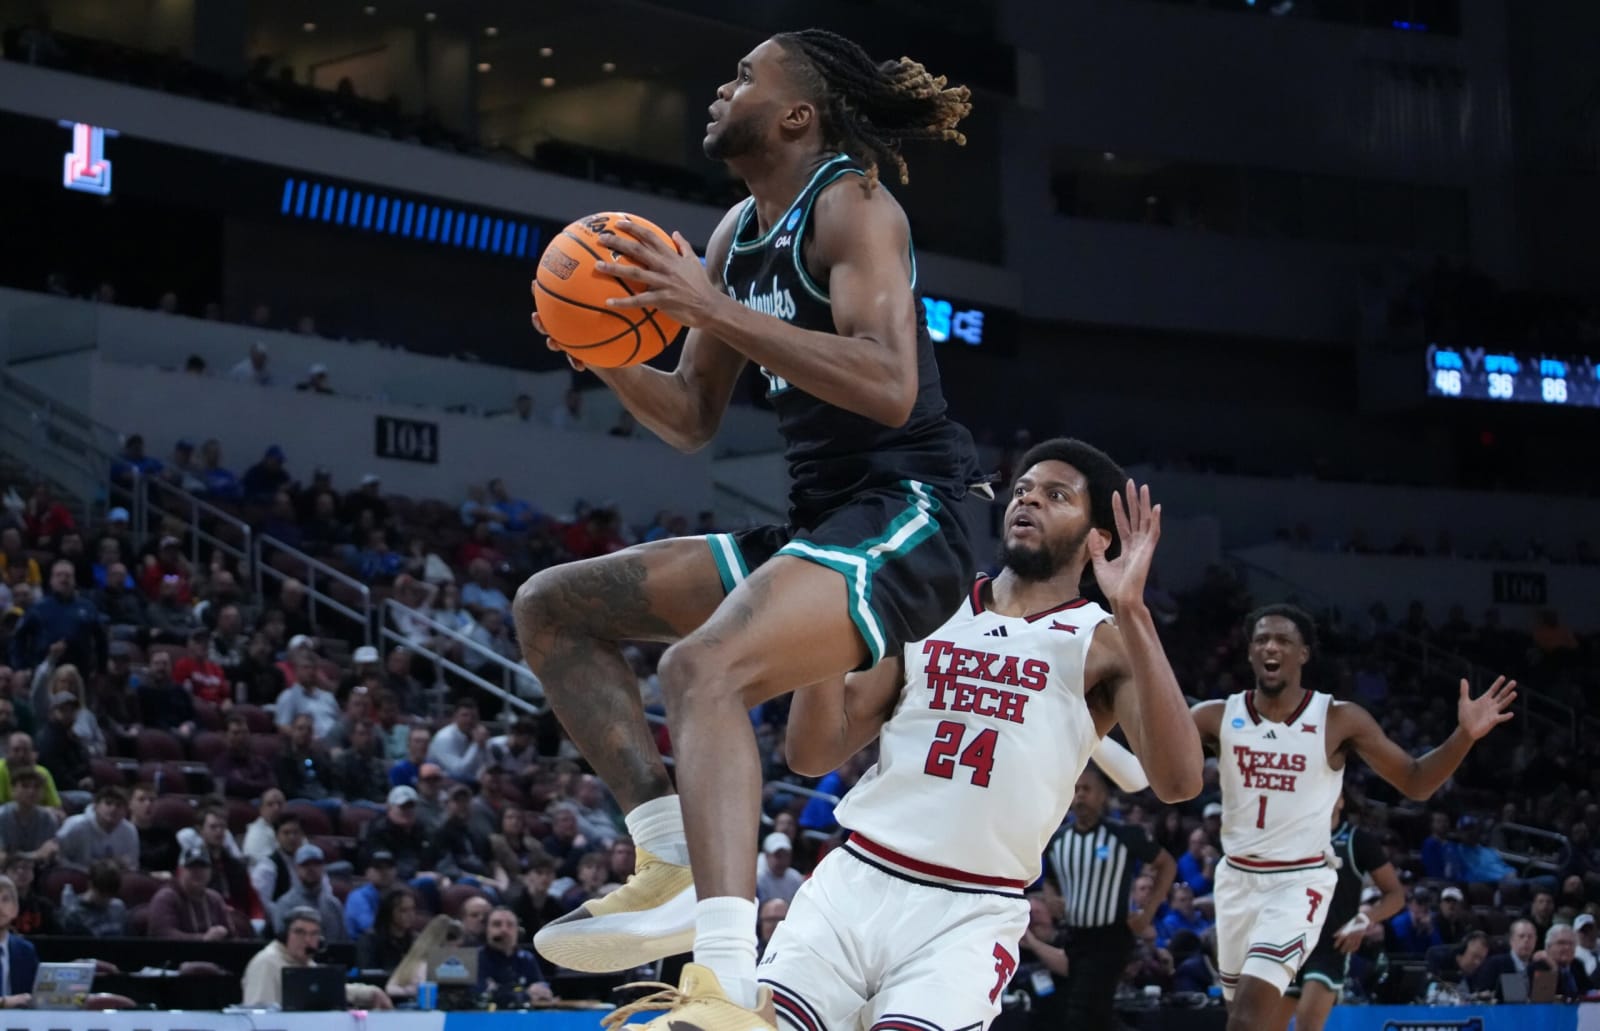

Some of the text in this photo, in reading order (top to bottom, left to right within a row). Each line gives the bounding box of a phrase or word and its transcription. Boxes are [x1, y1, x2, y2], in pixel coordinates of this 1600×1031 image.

[386, 420, 432, 459] 104
[922, 639, 1050, 692] TEXAS
[927, 673, 1030, 724] TECH
[924, 720, 999, 788] 24
[1233, 745, 1307, 772] TEXAS
[1240, 765, 1297, 792] TECH
[1256, 795, 1268, 829] 1
